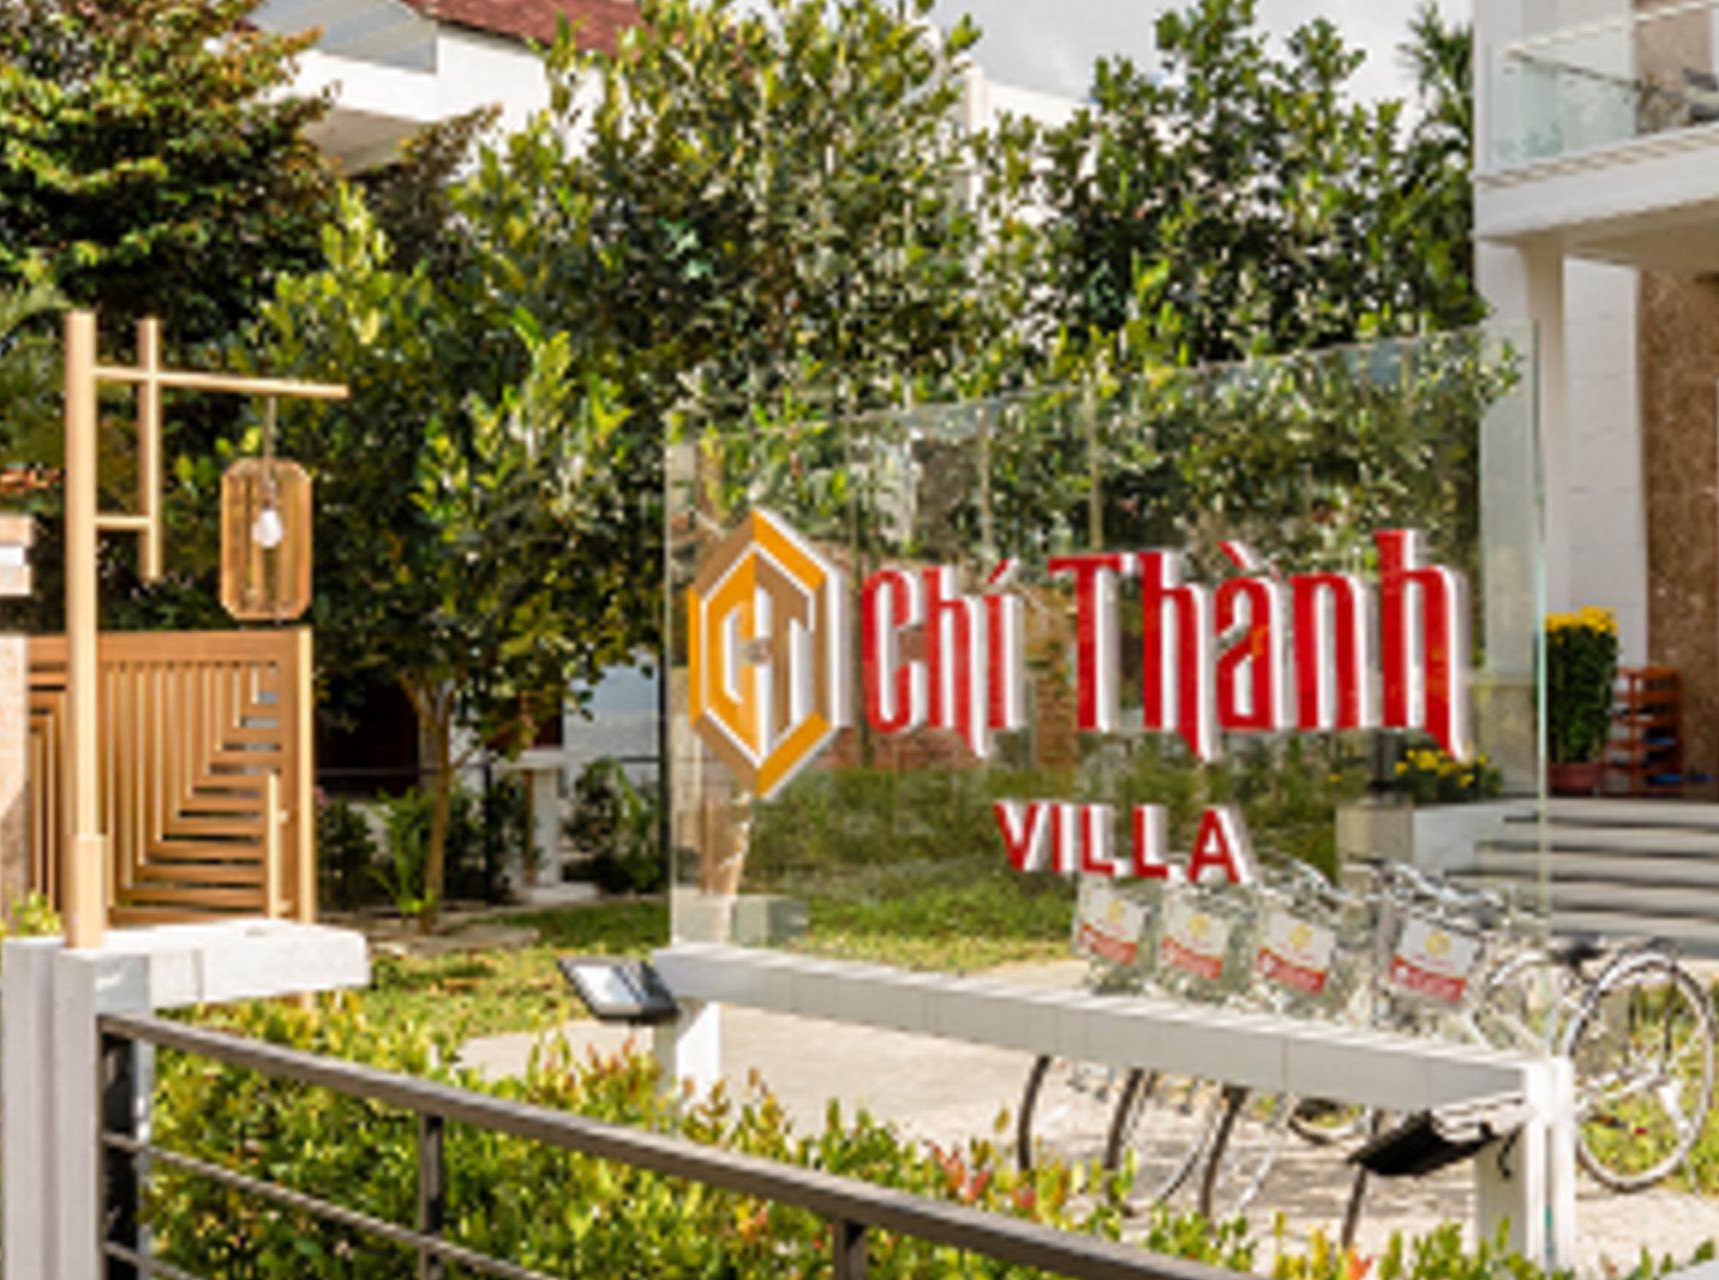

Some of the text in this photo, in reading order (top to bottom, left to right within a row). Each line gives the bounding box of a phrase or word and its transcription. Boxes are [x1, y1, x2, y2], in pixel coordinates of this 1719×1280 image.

[860, 528, 1465, 762] Chí Thành
[994, 803, 1246, 885] VILLA
